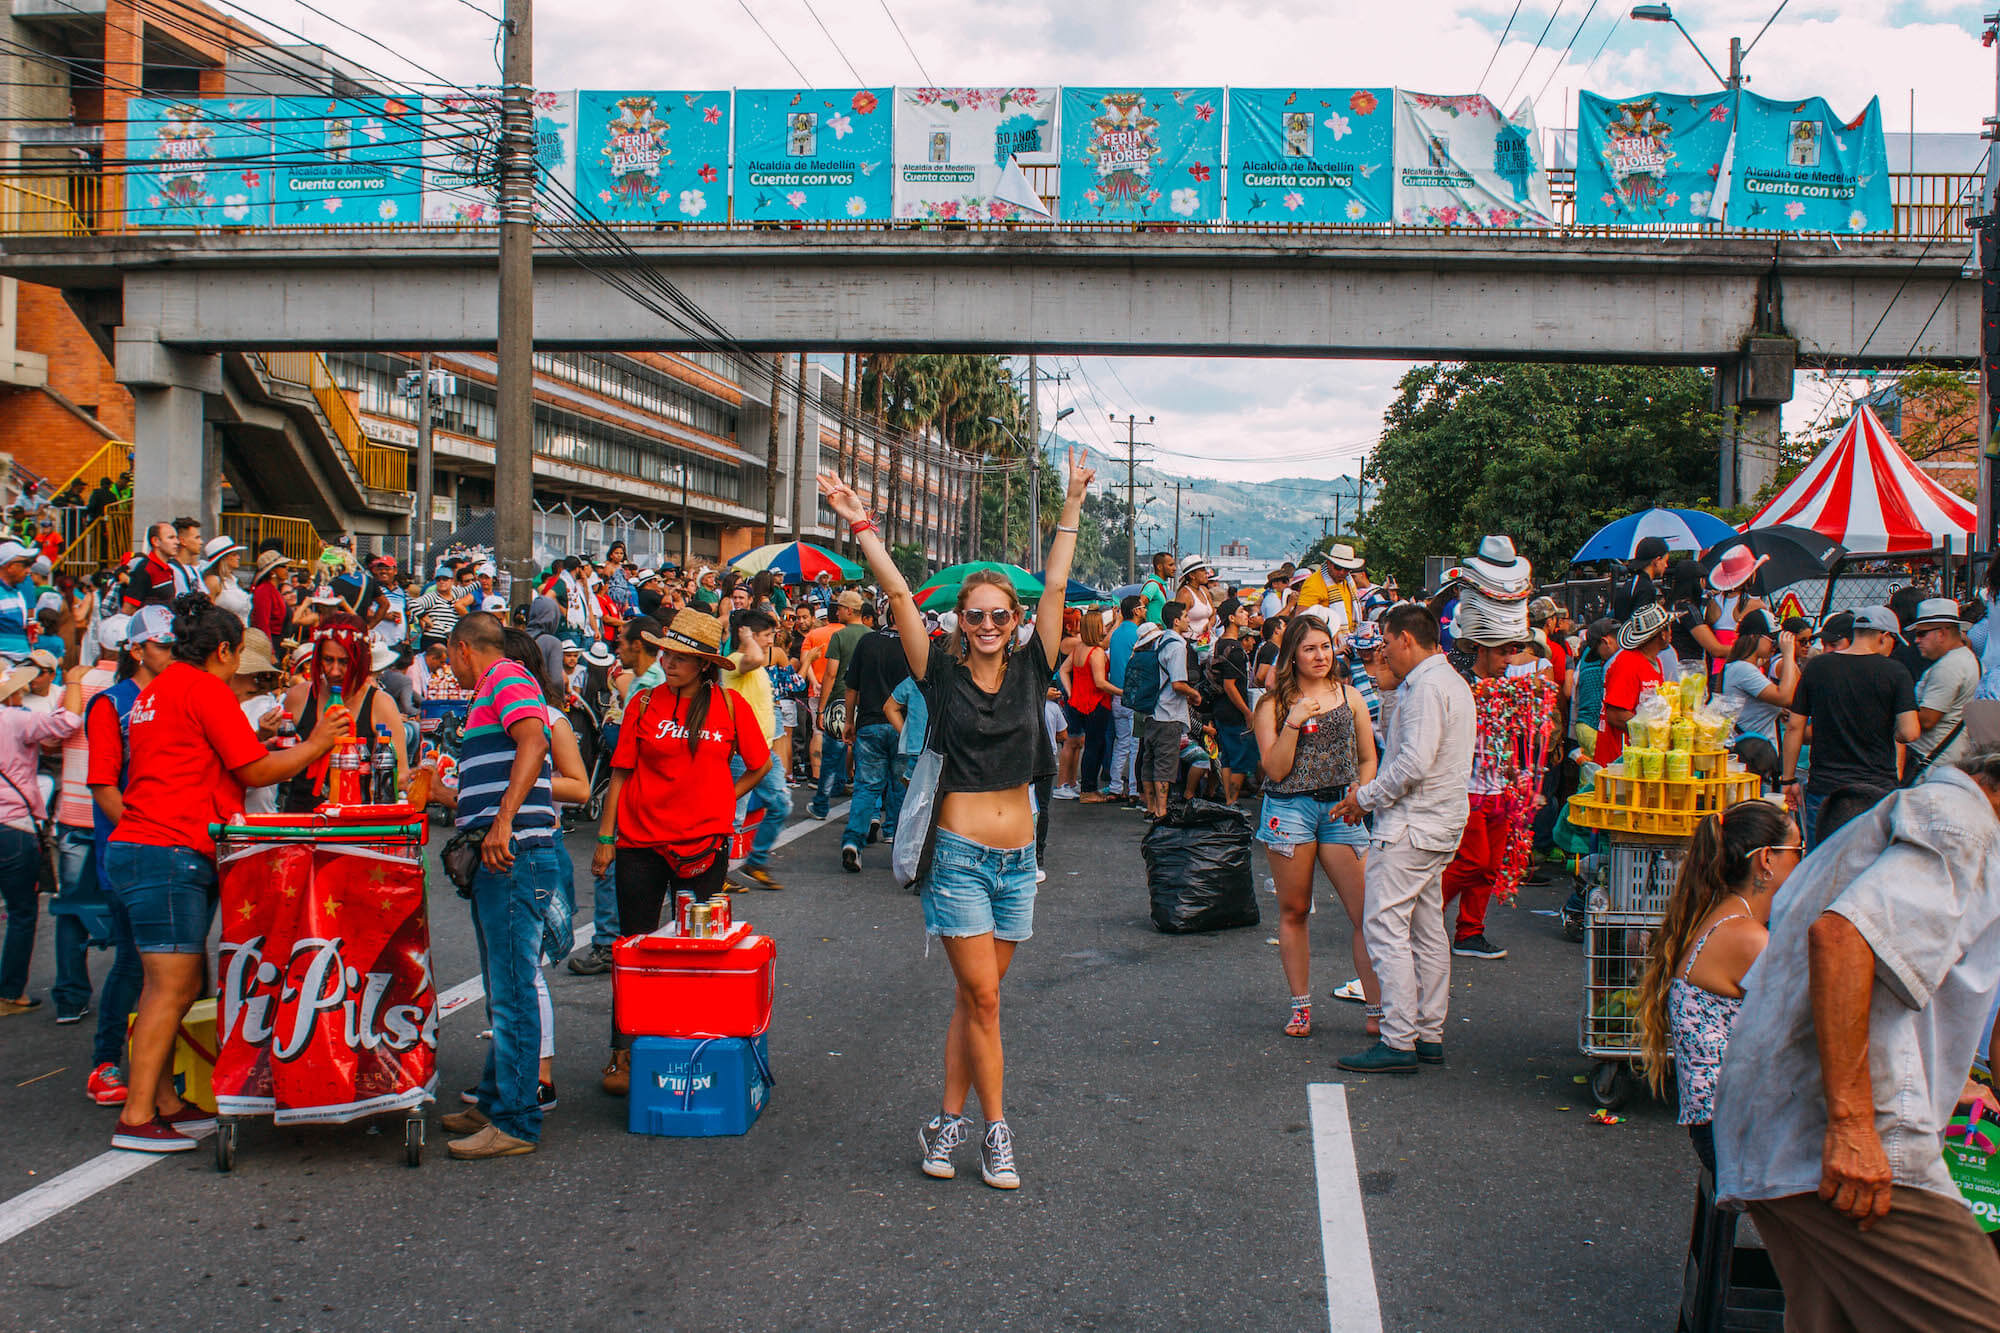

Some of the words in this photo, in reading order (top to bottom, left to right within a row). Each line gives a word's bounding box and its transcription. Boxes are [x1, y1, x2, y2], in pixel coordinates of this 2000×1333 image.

[618, 132, 655, 148] FERIA
[997, 131, 1010, 145] 60
[1102, 130, 1142, 146] FERIA
[1616, 135, 1656, 151] FERIA
[164, 139, 202, 156] FERIA
[1496, 140, 1510, 153] 60
[614, 149, 661, 166] FLORES
[1099, 148, 1150, 165] FLORES
[1615, 152, 1665, 169] FLORES
[748, 160, 791, 170] Alcaldía
[794, 160, 808, 170] de
[810, 159, 856, 170] Medellín
[1242, 160, 1288, 171] Alcaldía
[1290, 160, 1304, 171] de
[1307, 160, 1354, 172] Medellín
[750, 173, 800, 185] Cuenta
[802, 174, 827, 185] con
[829, 174, 853, 185] vos
[904, 172, 939, 181] Cuenta
[940, 173, 957, 182] con
[957, 173, 974, 182] vos
[1244, 173, 1297, 186] Cuenta
[1299, 176, 1326, 187] con
[1328, 175, 1352, 187] vos
[1744, 165, 1791, 179] Alcaldía
[1793, 170, 1809, 180] de
[289, 178, 335, 190] Cuenta
[337, 179, 361, 190] con
[363, 178, 385, 189] vos
[1746, 178, 1800, 195] Cuenta
[1801, 185, 1829, 198] con
[1832, 187, 1855, 198] vos
[655, 719, 710, 739] Pilsn
